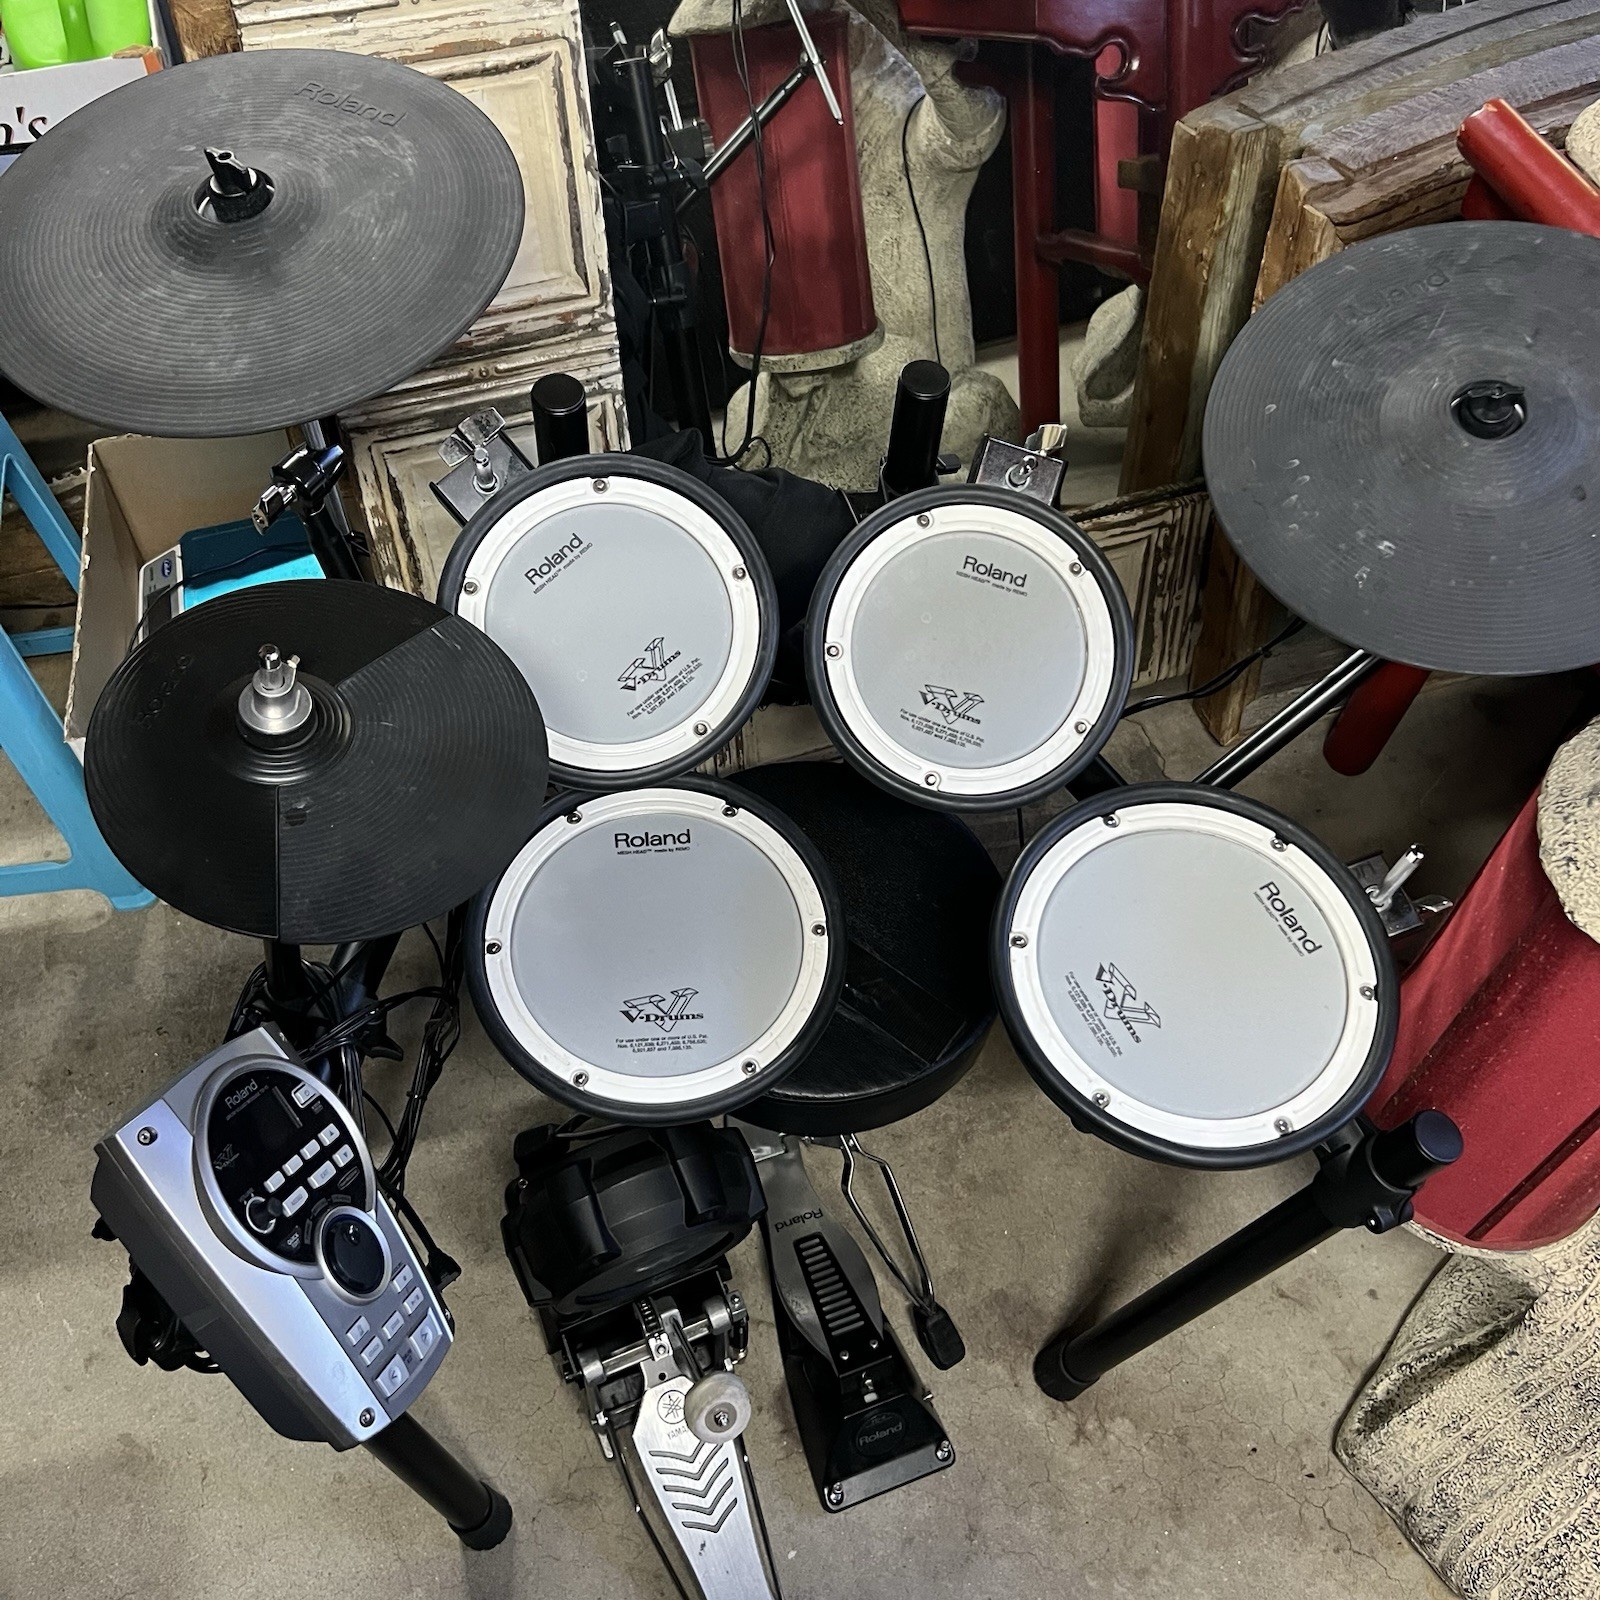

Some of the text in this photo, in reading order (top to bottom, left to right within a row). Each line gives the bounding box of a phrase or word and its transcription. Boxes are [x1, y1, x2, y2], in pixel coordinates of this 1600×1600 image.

[294, 82, 407, 127] Roland
[524, 532, 583, 585] Roland
[962, 555, 1027, 588] Roland
[620, 650, 681, 691] V-Drums
[918, 691, 981, 725] V-Drums
[614, 828, 691, 848] Roland
[1259, 881, 1323, 954] Roland
[619, 1009, 704, 1023] V-Drums
[1095, 962, 1142, 1043] V-Drums
[225, 1079, 258, 1109] Roland
[774, 1208, 823, 1233] Roland
[859, 1422, 902, 1446] Roland
